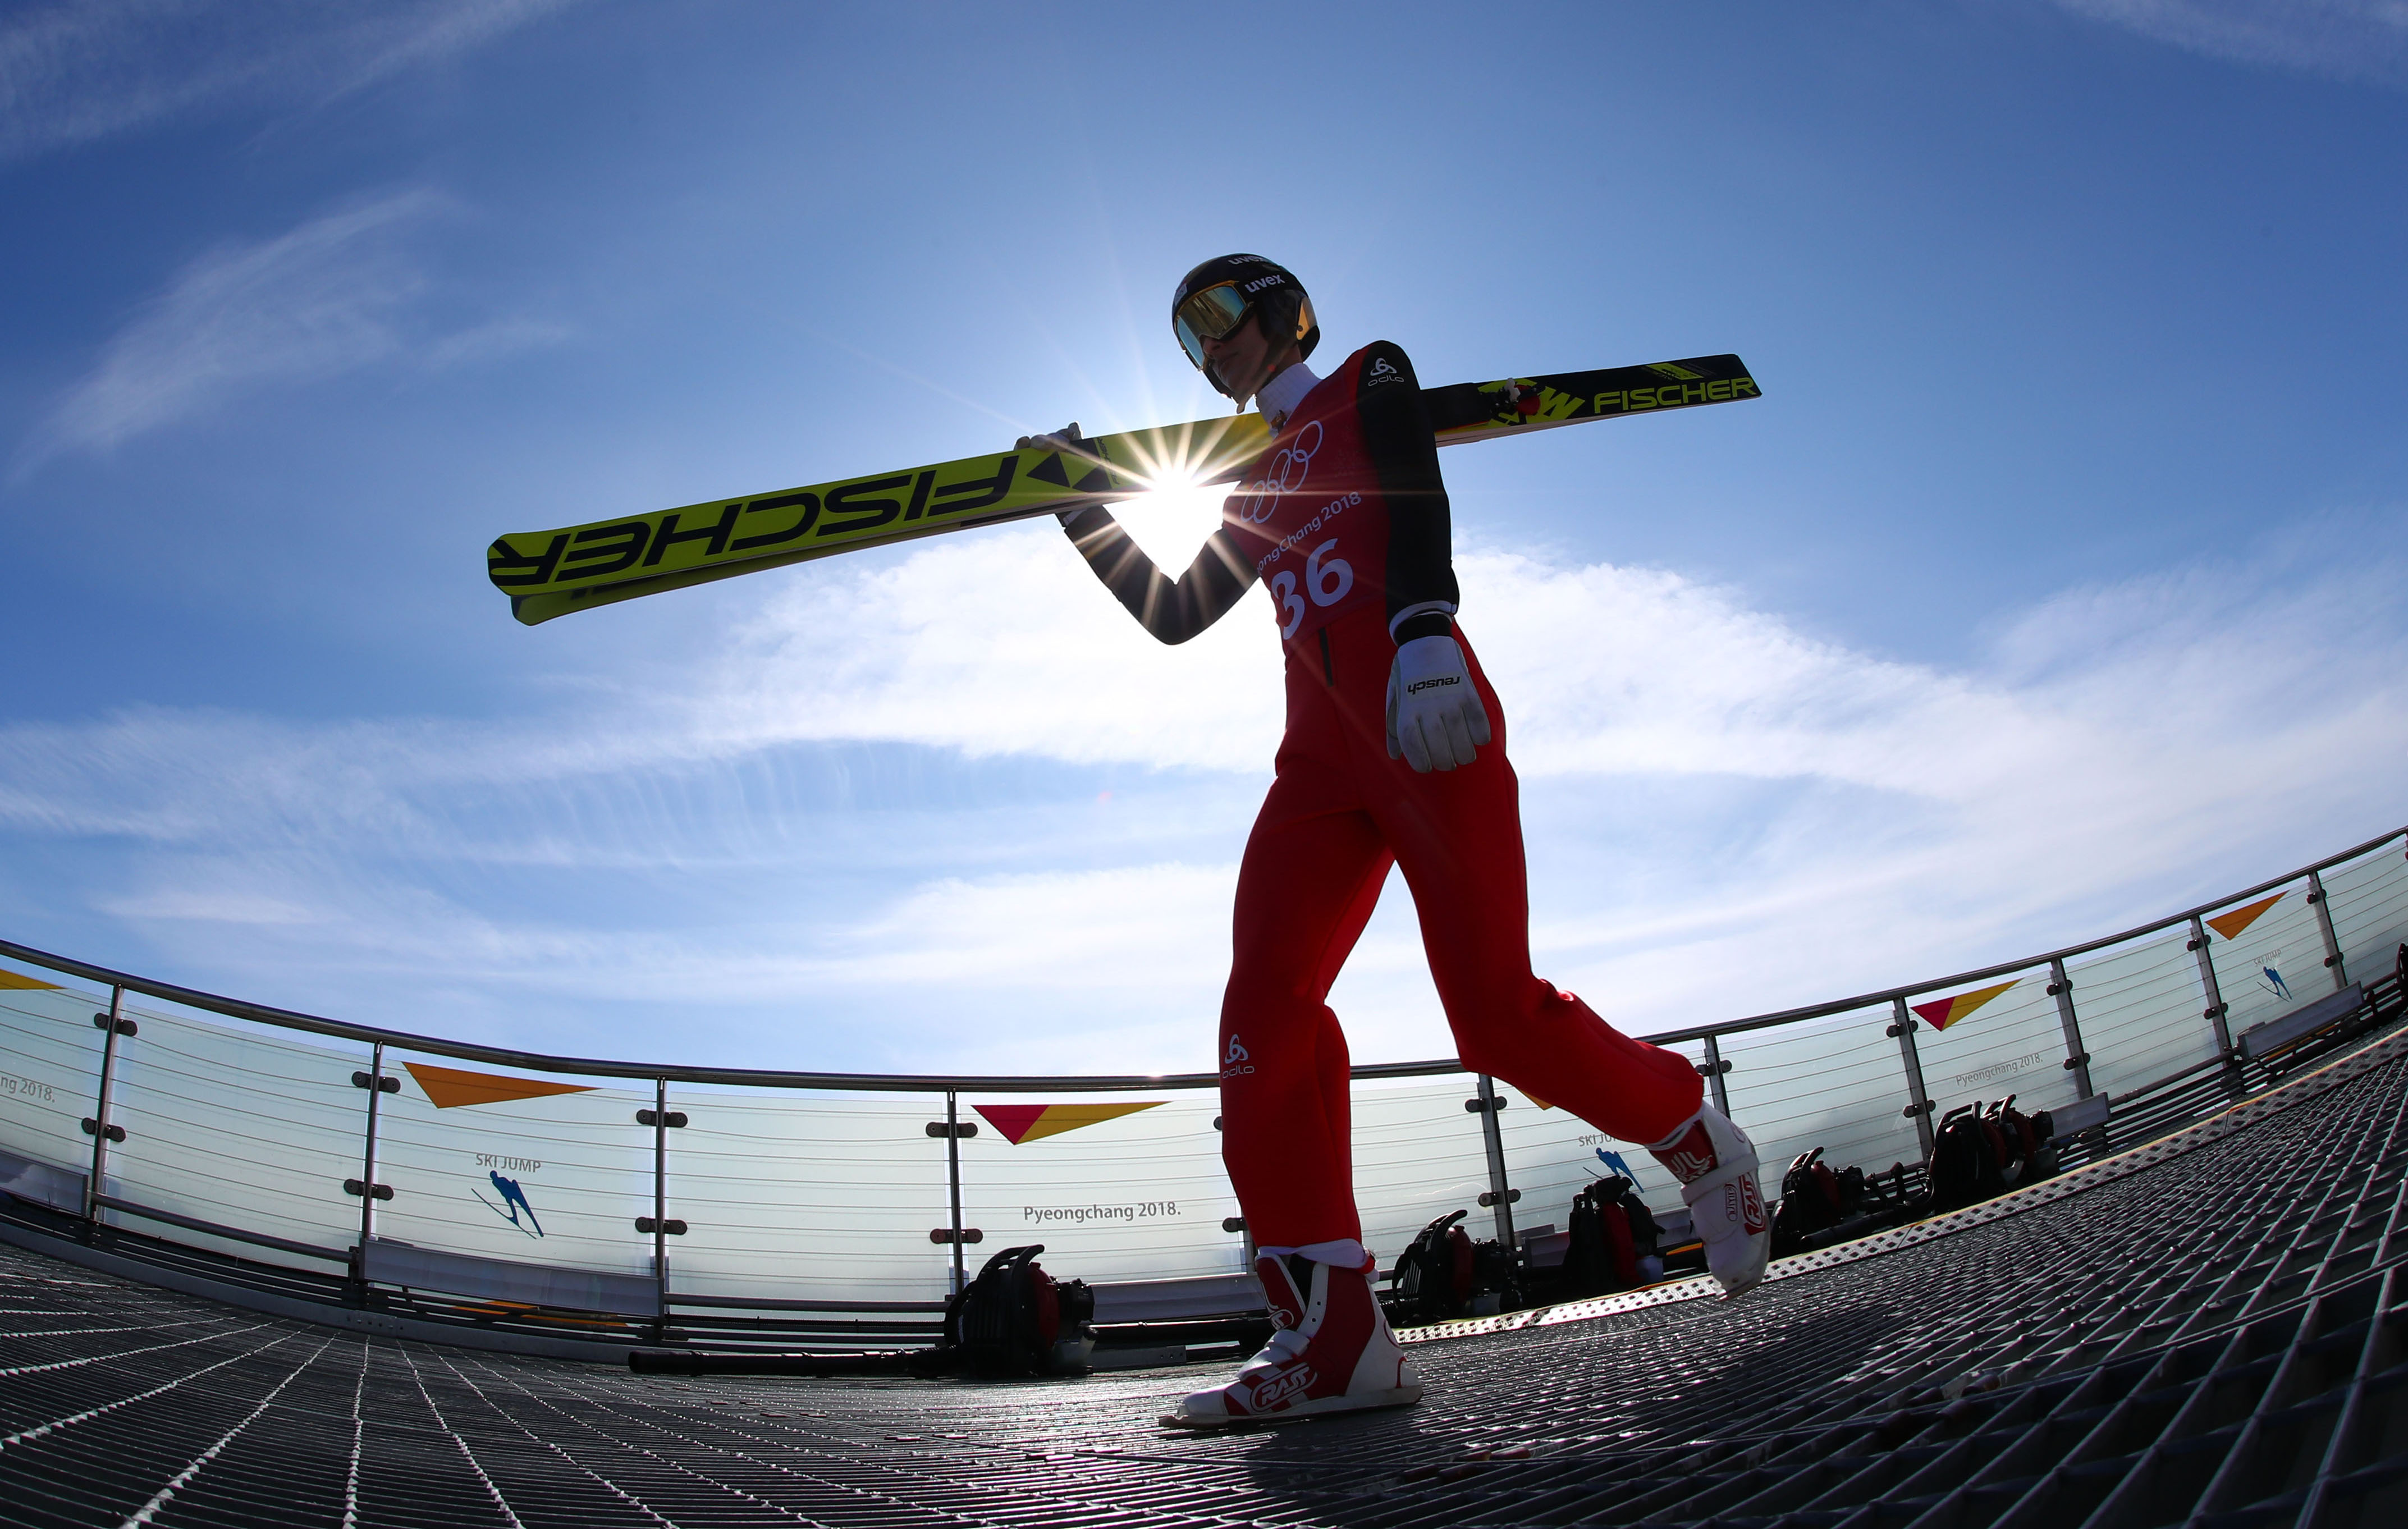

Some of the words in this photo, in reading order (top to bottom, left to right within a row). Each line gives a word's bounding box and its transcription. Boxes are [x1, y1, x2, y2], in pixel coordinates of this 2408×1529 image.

[1245, 274, 1286, 292] uvex
[1368, 375, 1404, 386] odlo
[1594, 377, 1756, 414] FISCHER
[1321, 492, 1362, 521] 2018
[488, 455, 1020, 586] FISCHER
[1271, 538, 1353, 640] 36
[1407, 676, 1461, 695] reusch
[2254, 956, 2264, 967] SKI
[2265, 949, 2281, 963] JUMP
[1222, 1065, 1255, 1079] odlo
[1956, 1065, 2018, 1087] Pyeongchang
[2018, 1052, 2043, 1068] 2018.
[20, 1078, 56, 1103] 2018.
[1578, 1134, 1596, 1147] SKI
[1599, 1133, 1616, 1144] JU
[475, 1153, 497, 1168] SKI
[501, 1156, 541, 1173] JUMP
[1024, 1205, 1134, 1224] Pyeongchang
[1138, 1201, 1182, 1217] 2018.
